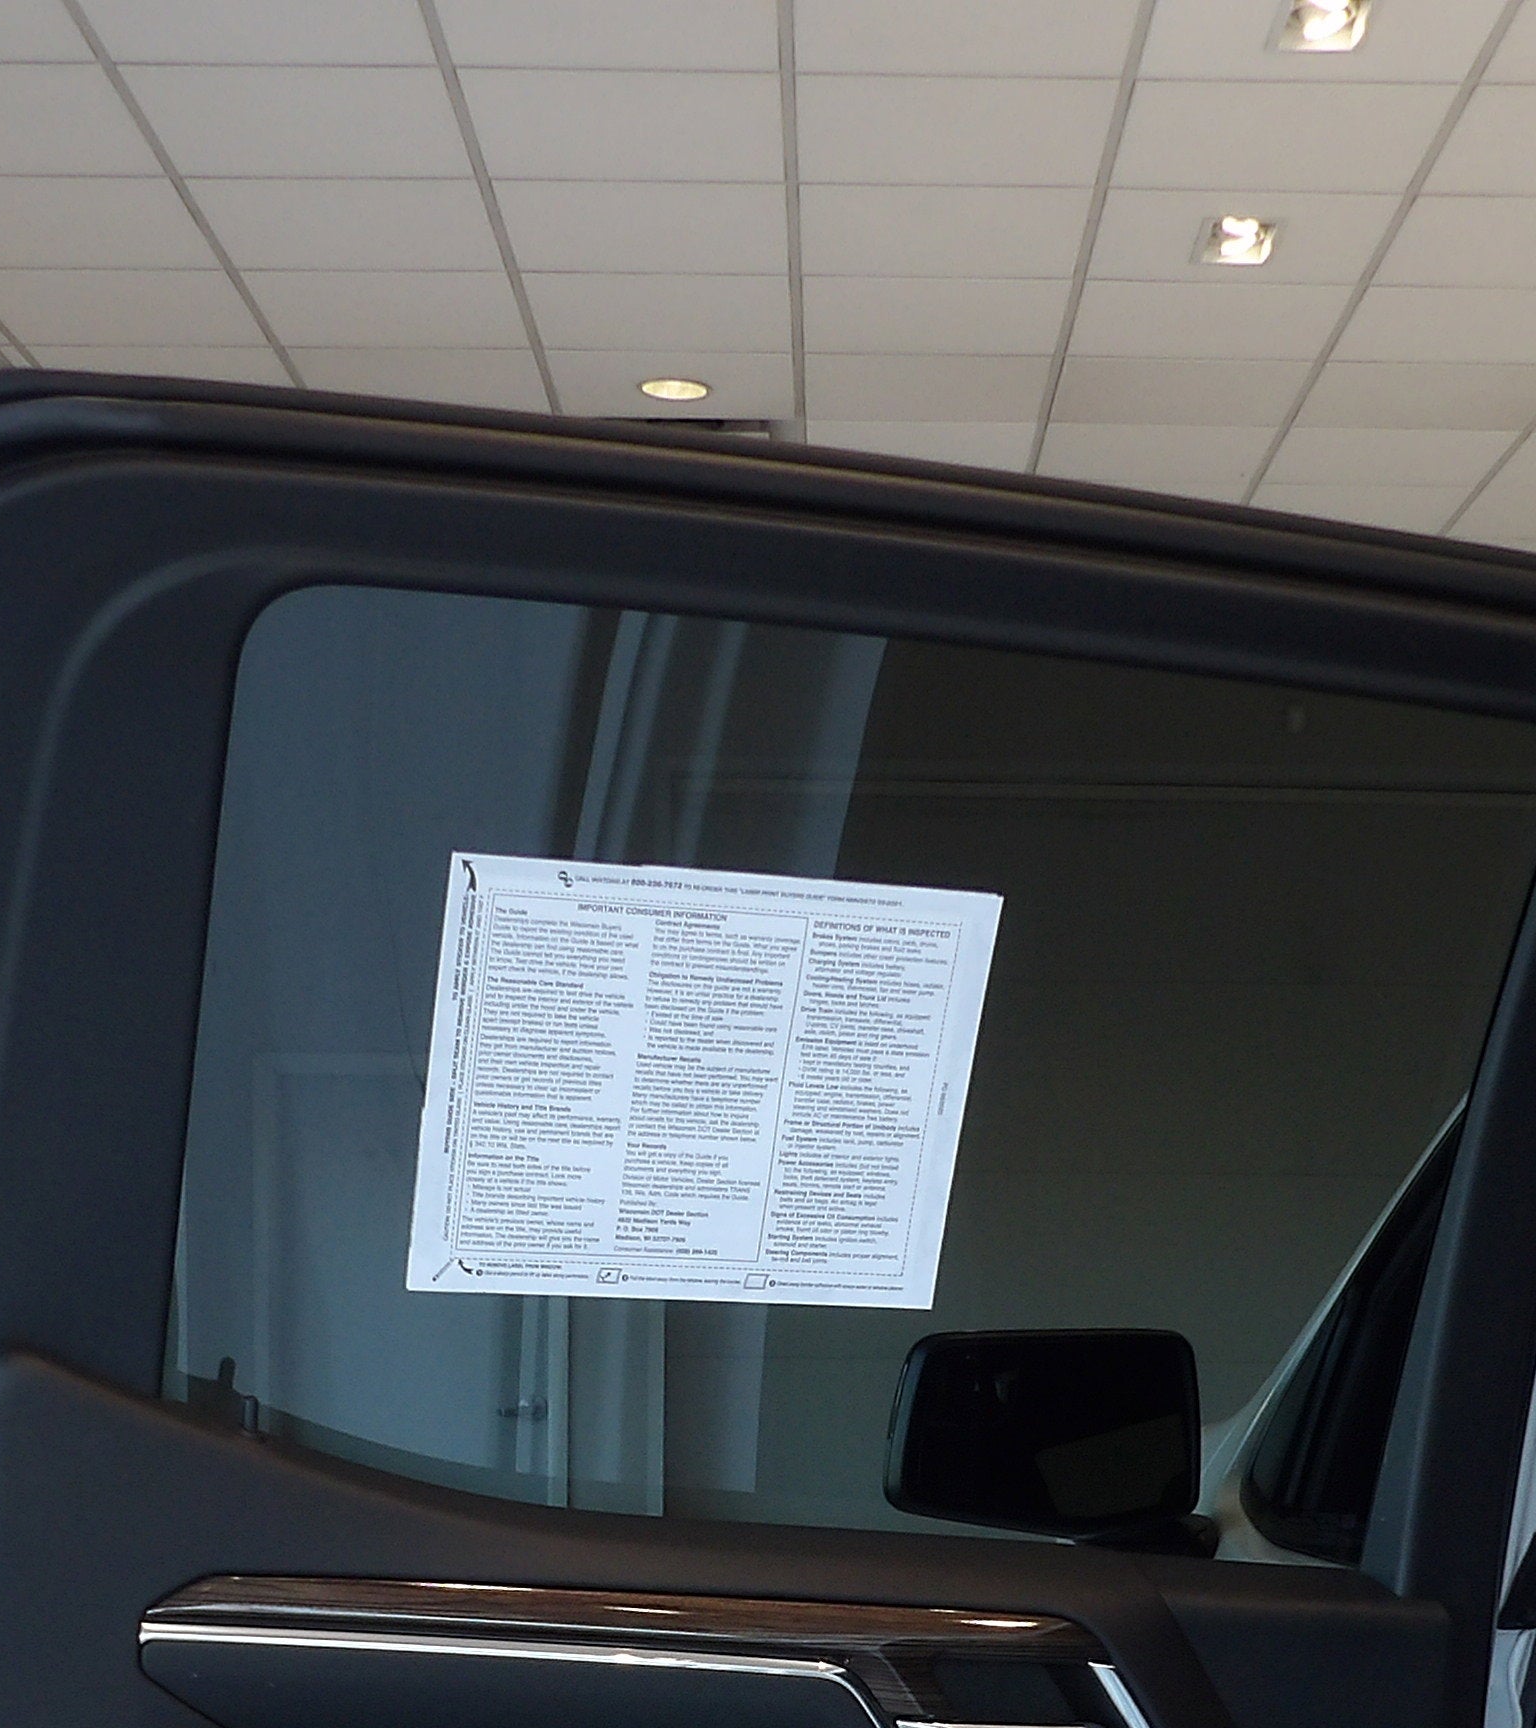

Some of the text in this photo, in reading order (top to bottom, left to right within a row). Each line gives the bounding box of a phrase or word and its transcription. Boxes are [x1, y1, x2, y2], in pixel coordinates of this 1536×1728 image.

[494, 906, 528, 915] The Guide
[577, 903, 728, 921] IMPORTANT CONSUMER INFORMATION
[654, 919, 720, 930] Contract Agreements
[813, 920, 951, 938] DEFINITIONS OF WHAT IS INSPECTED
[812, 932, 857, 942] Brakes System
[807, 957, 860, 968] Charging System
[499, 976, 537, 985] Reasonable
[555, 980, 584, 988] Standard
[648, 971, 680, 980] Obligation
[689, 974, 714, 982] Remedy
[715, 976, 753, 985] Undisclosed
[754, 978, 783, 987] Problems
[855, 977, 878, 985] System
[803, 990, 886, 1002] Doors, Hoods and Trunk Lid
[800, 1005, 833, 1014] Drive Train
[636, 1053, 678, 1061] Manufacturer
[472, 1101, 496, 1109] Vehicle
[496, 1102, 519, 1110] History
[548, 1104, 571, 1112] Brands
[811, 1120, 840, 1128] Structural
[871, 1123, 896, 1131] Unibody
[467, 1152, 504, 1160] Information
[777, 1158, 833, 1167] Power Accessories
[773, 1188, 807, 1196] Restraining
[808, 1190, 831, 1198] Devices
[618, 1207, 650, 1215] Wisconsin
[836, 1213, 875, 1221] Consumption
[764, 1248, 828, 1257] Steering Components
